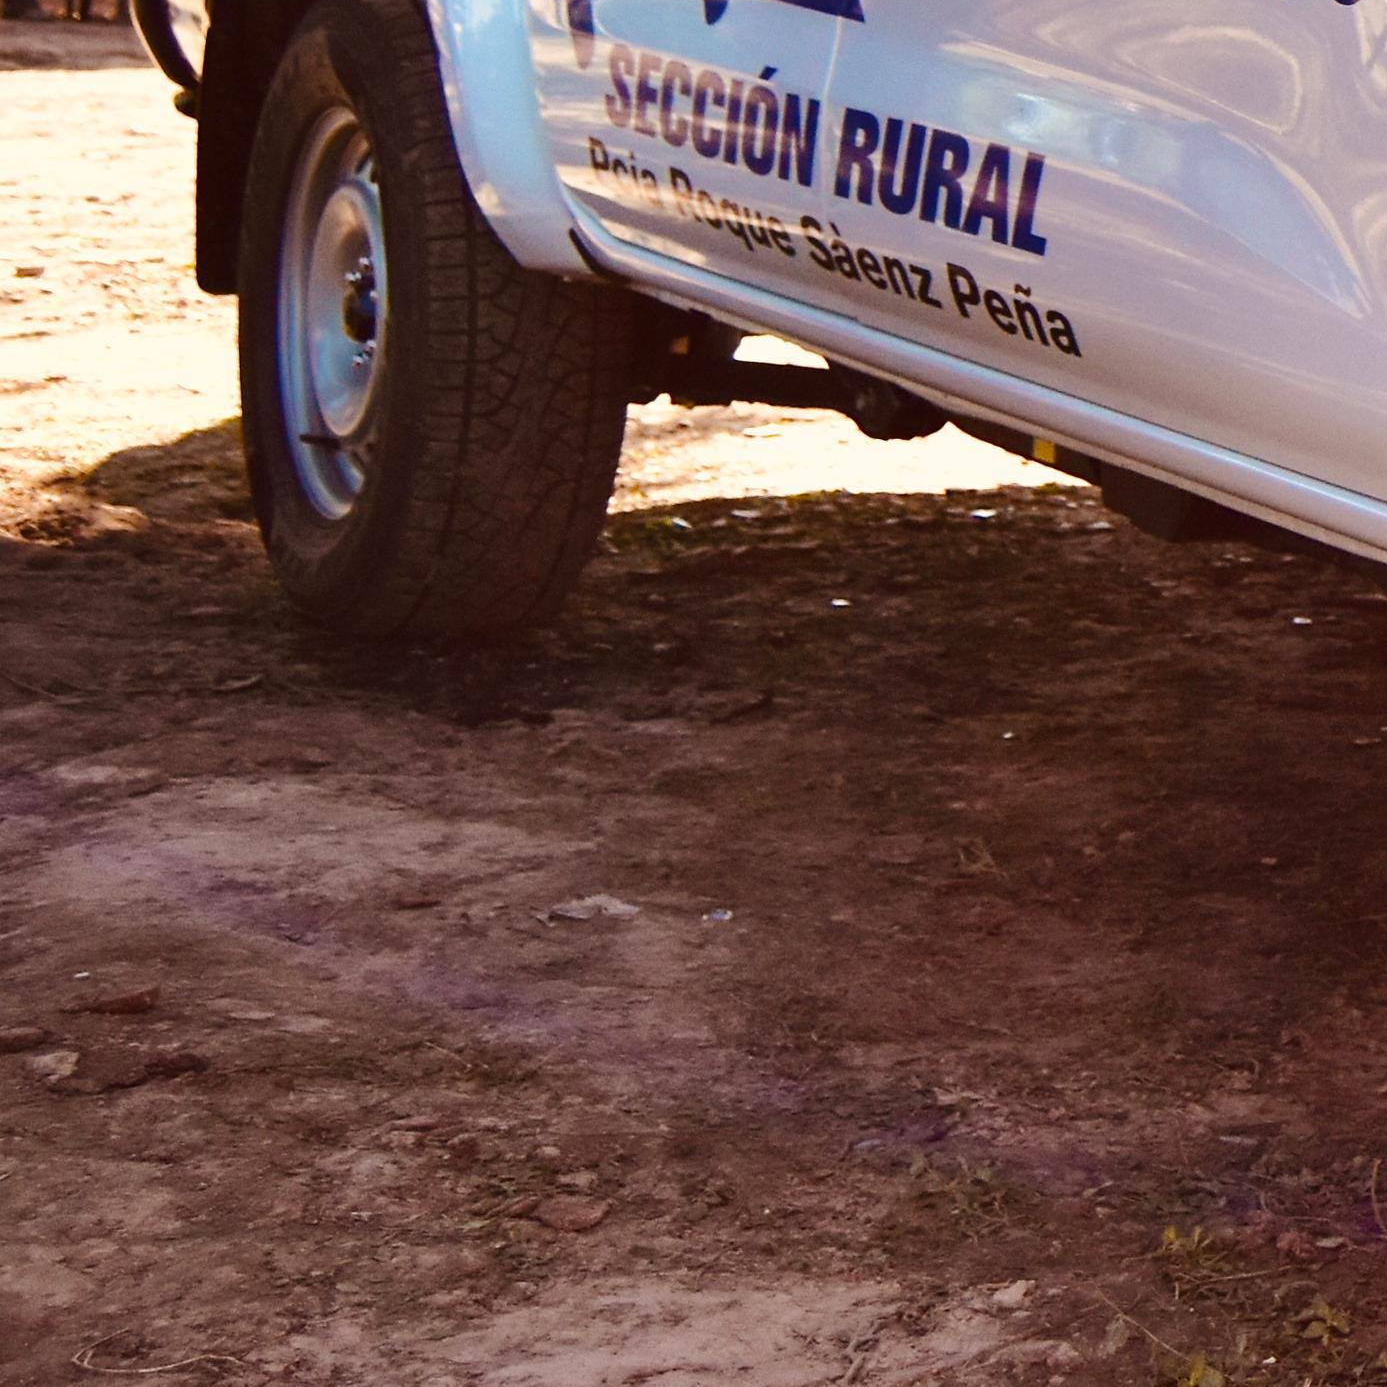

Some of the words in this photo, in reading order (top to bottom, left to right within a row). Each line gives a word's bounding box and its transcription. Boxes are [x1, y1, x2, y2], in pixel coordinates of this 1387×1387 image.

[604, 43, 821, 187] SECCIÓN
[833, 106, 1048, 257] RURAL
[669, 166, 797, 257] Roque
[946, 261, 1083, 358] Peña
